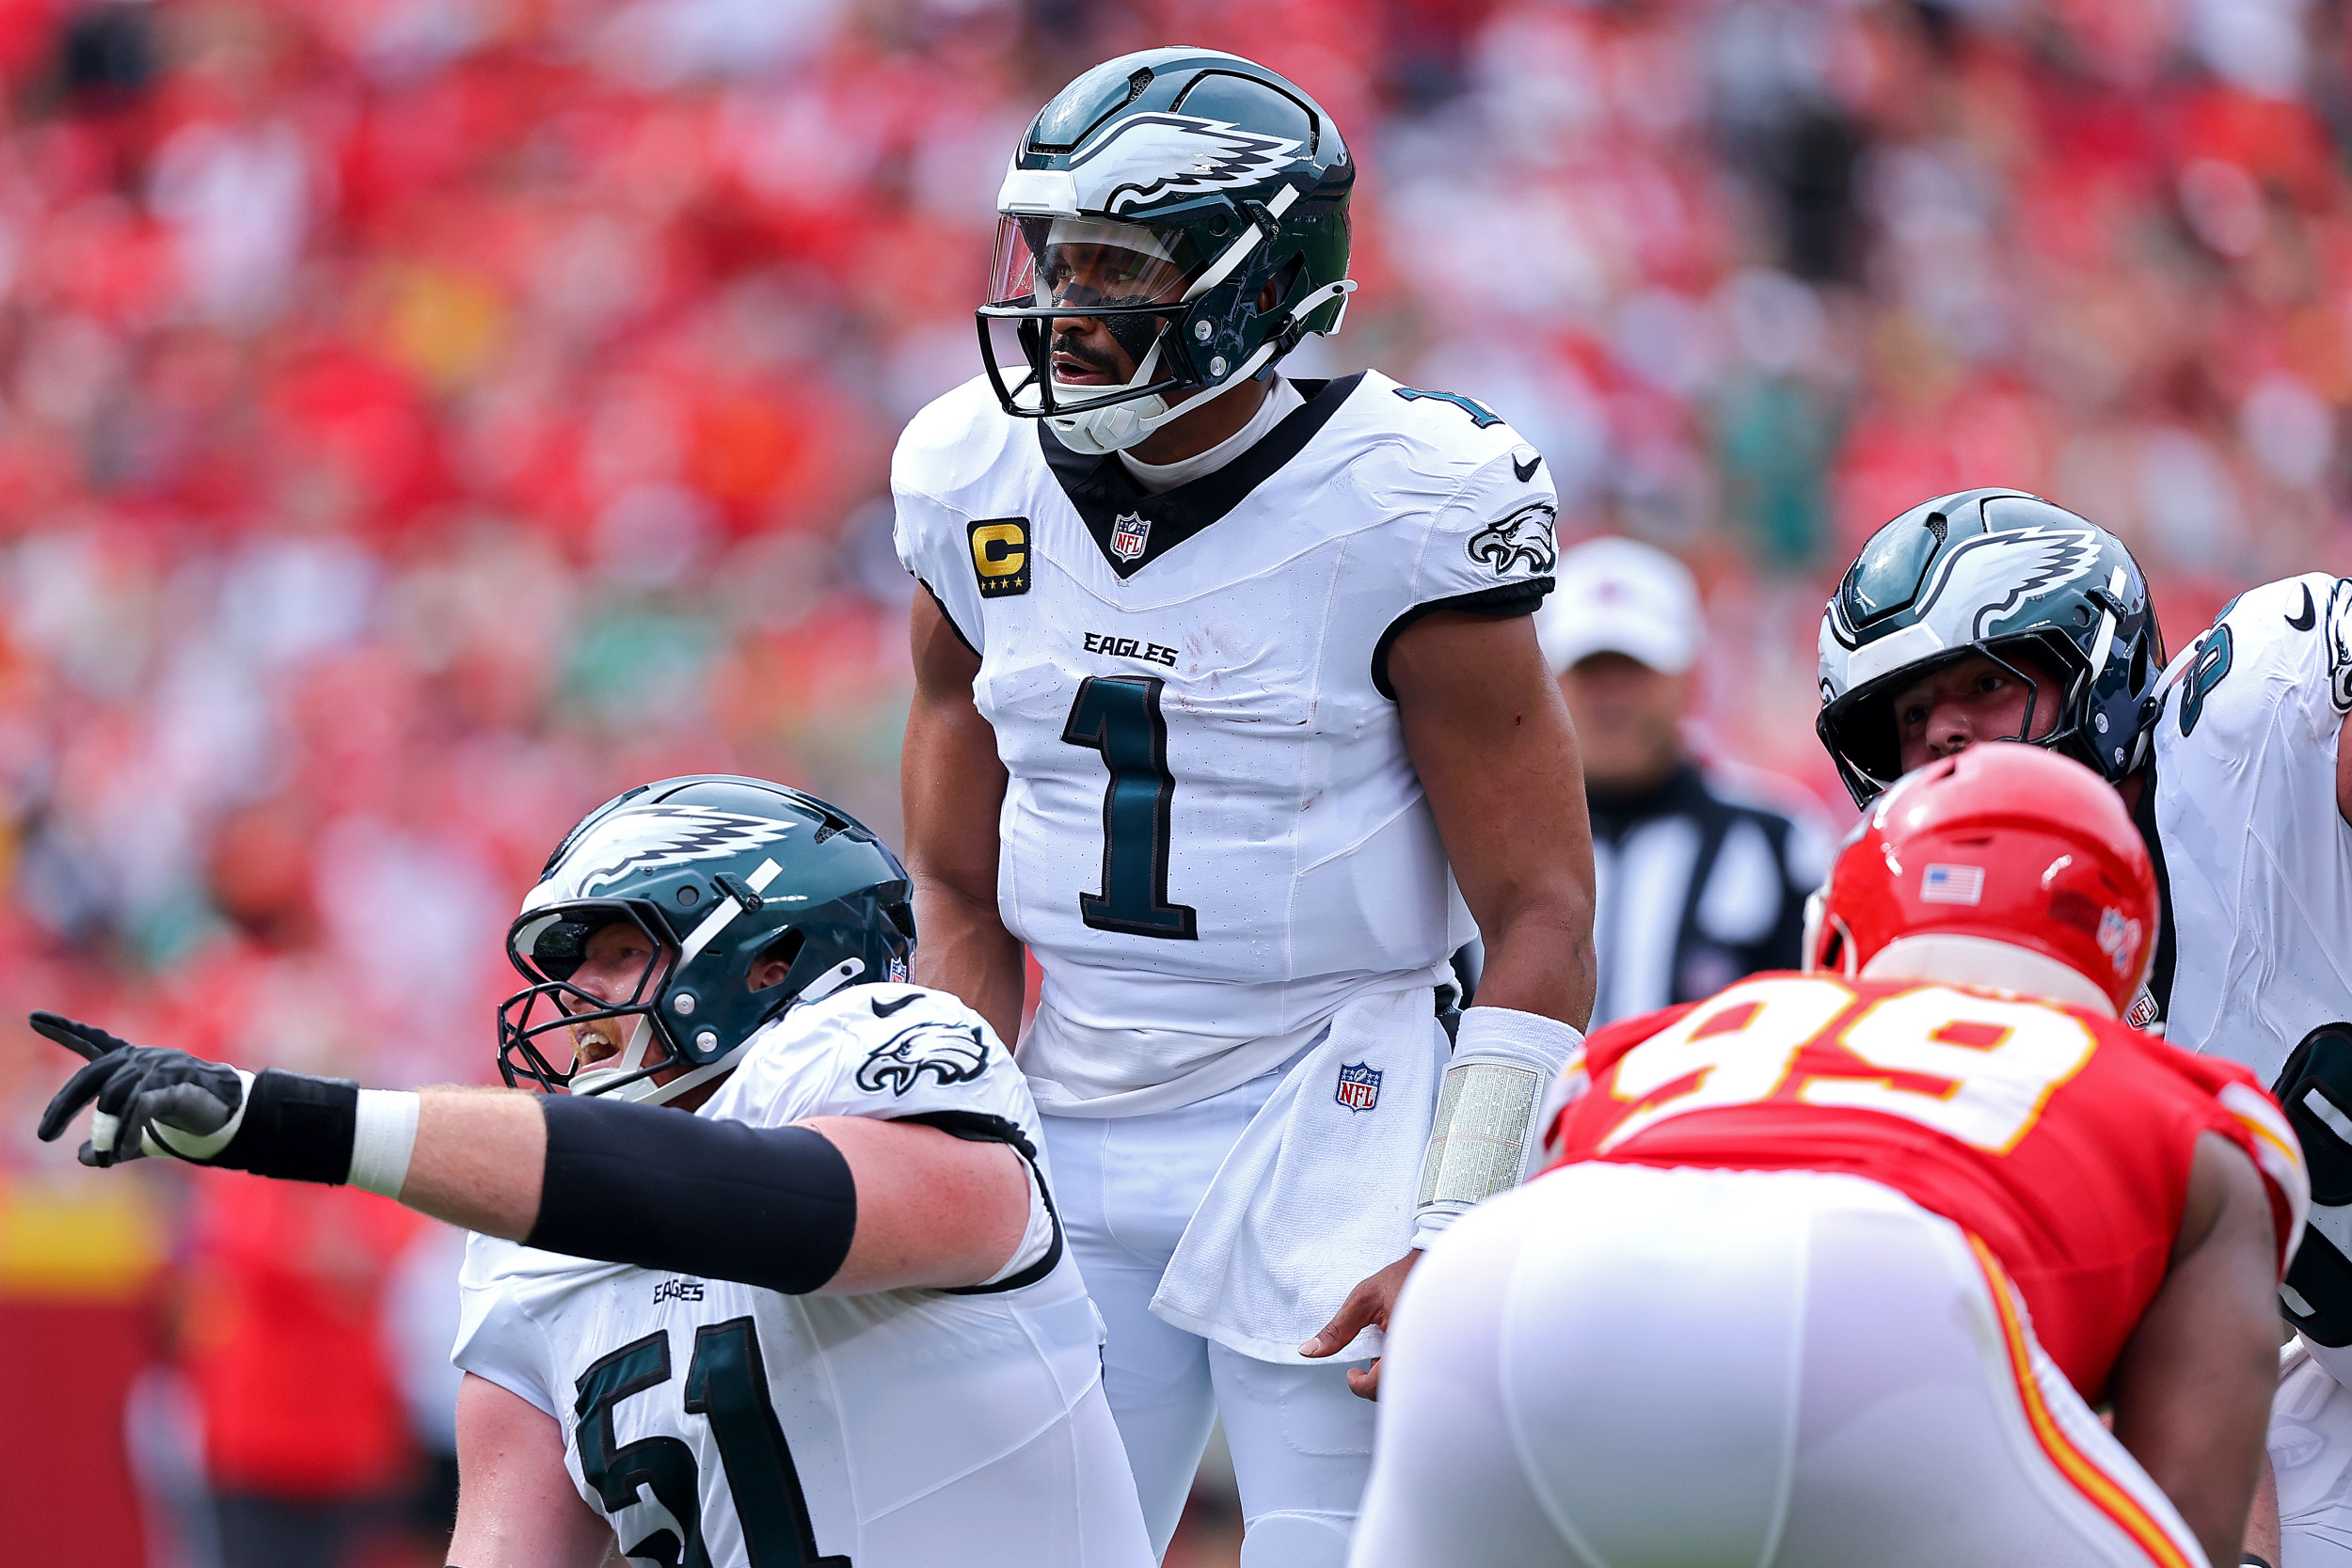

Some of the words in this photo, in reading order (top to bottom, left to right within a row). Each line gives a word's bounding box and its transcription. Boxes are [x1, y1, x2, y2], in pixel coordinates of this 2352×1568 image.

[1392, 387, 1505, 429] 1
[972, 523, 1025, 578] C
[1117, 533, 1139, 553] NFL
[1083, 631, 1179, 667] EAGLES
[1060, 674, 1200, 941] 1
[2131, 1000, 2153, 1024] NFL
[1597, 976, 2099, 1157] 99
[1339, 1082, 1374, 1108] NFL
[574, 1314, 853, 1568] 51
